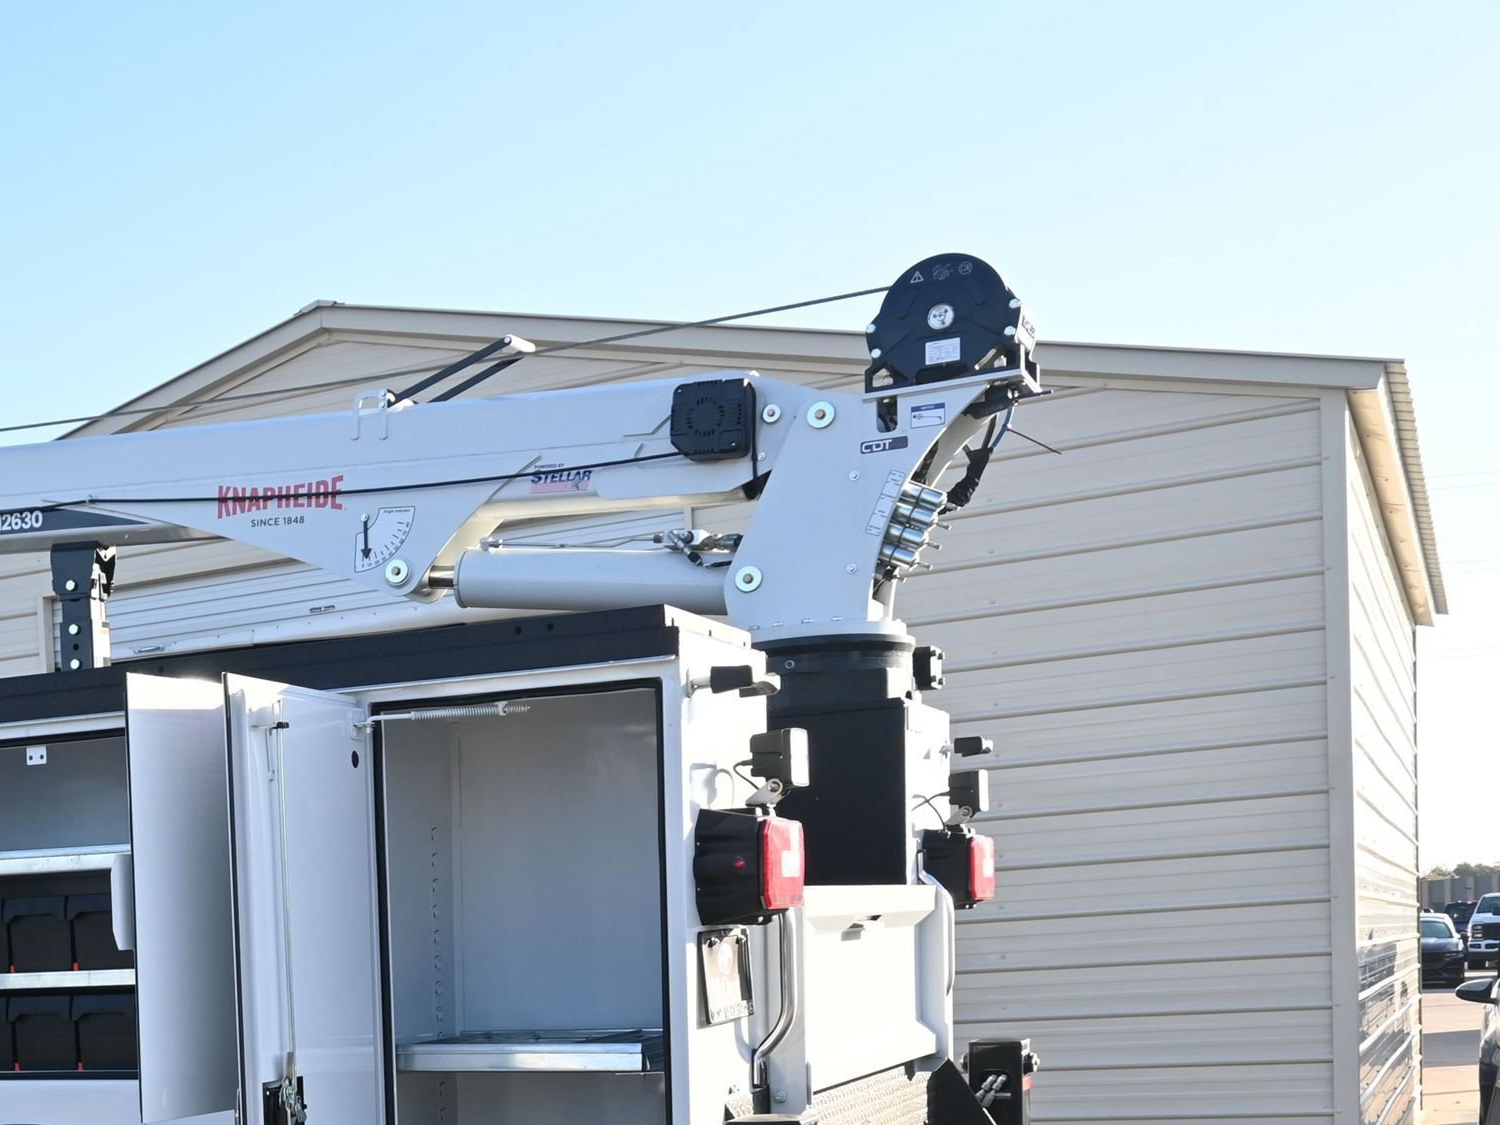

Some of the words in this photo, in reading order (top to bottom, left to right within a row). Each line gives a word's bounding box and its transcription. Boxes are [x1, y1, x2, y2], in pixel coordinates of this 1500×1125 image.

[861, 439, 893, 453] CDT
[531, 469, 592, 484] STELLAR
[217, 475, 345, 519] KNAPHEIDE
[251, 517, 280, 528] SINCE
[283, 515, 305, 526] 1848
